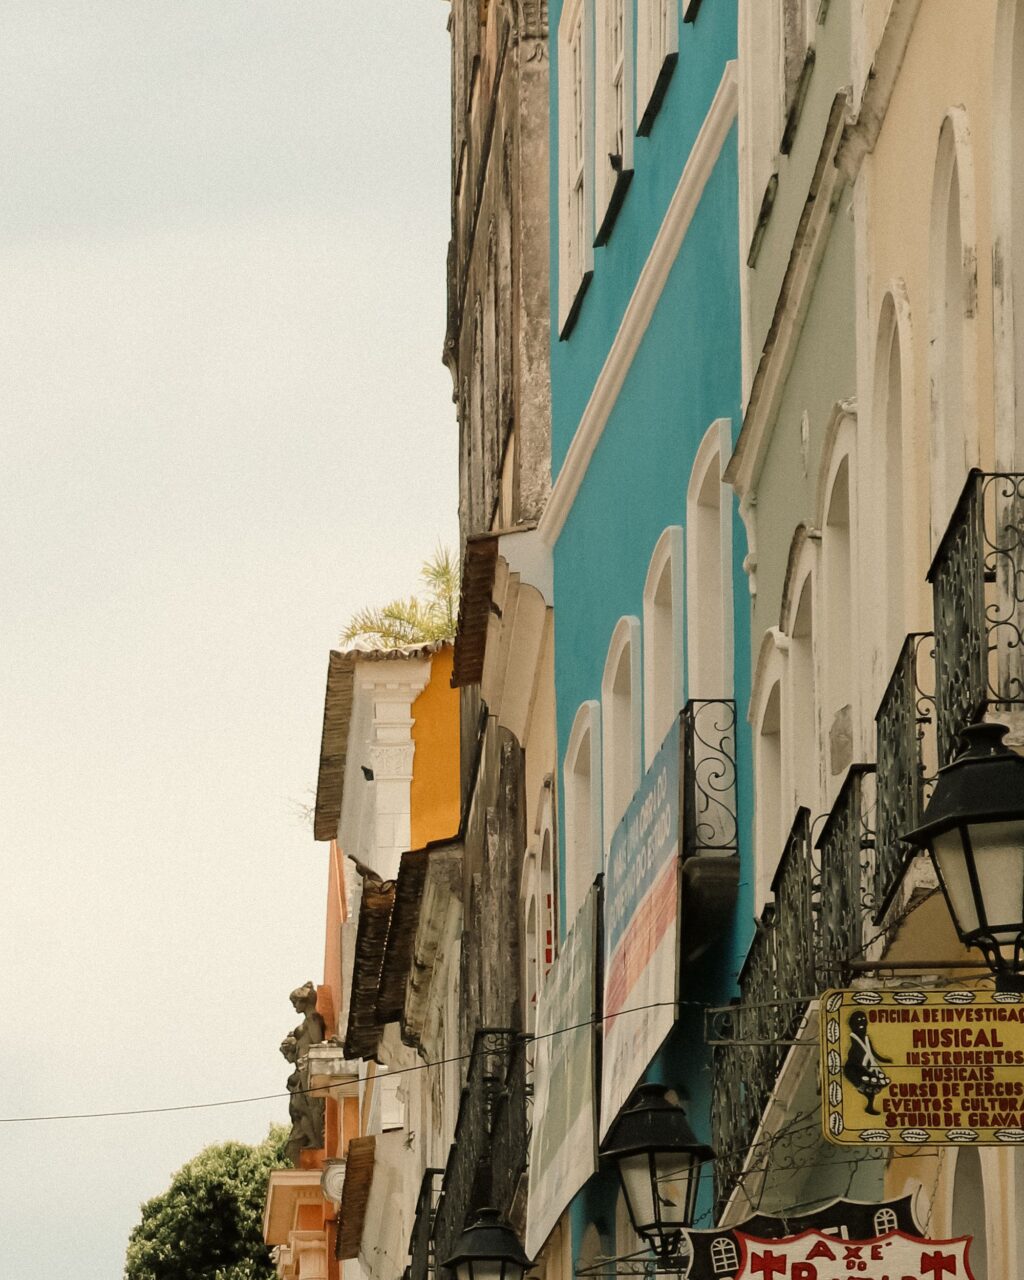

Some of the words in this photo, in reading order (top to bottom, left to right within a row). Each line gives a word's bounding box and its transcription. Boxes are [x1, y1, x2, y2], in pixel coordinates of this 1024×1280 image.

[868, 1008, 920, 1023] OFICINA
[922, 1008, 939, 1023] DE
[912, 1028, 1004, 1048] MUSICAL
[906, 1050, 1024, 1065] INSTRUMENTOS
[921, 1066, 994, 1082] MUSICAIS
[889, 1082, 938, 1097] CURSO
[942, 1082, 960, 1097] DE
[883, 1098, 953, 1112] EVENTOS
[885, 1112, 941, 1128] STUDIO
[944, 1113, 961, 1127] DE
[845, 1259, 867, 1271] DO
